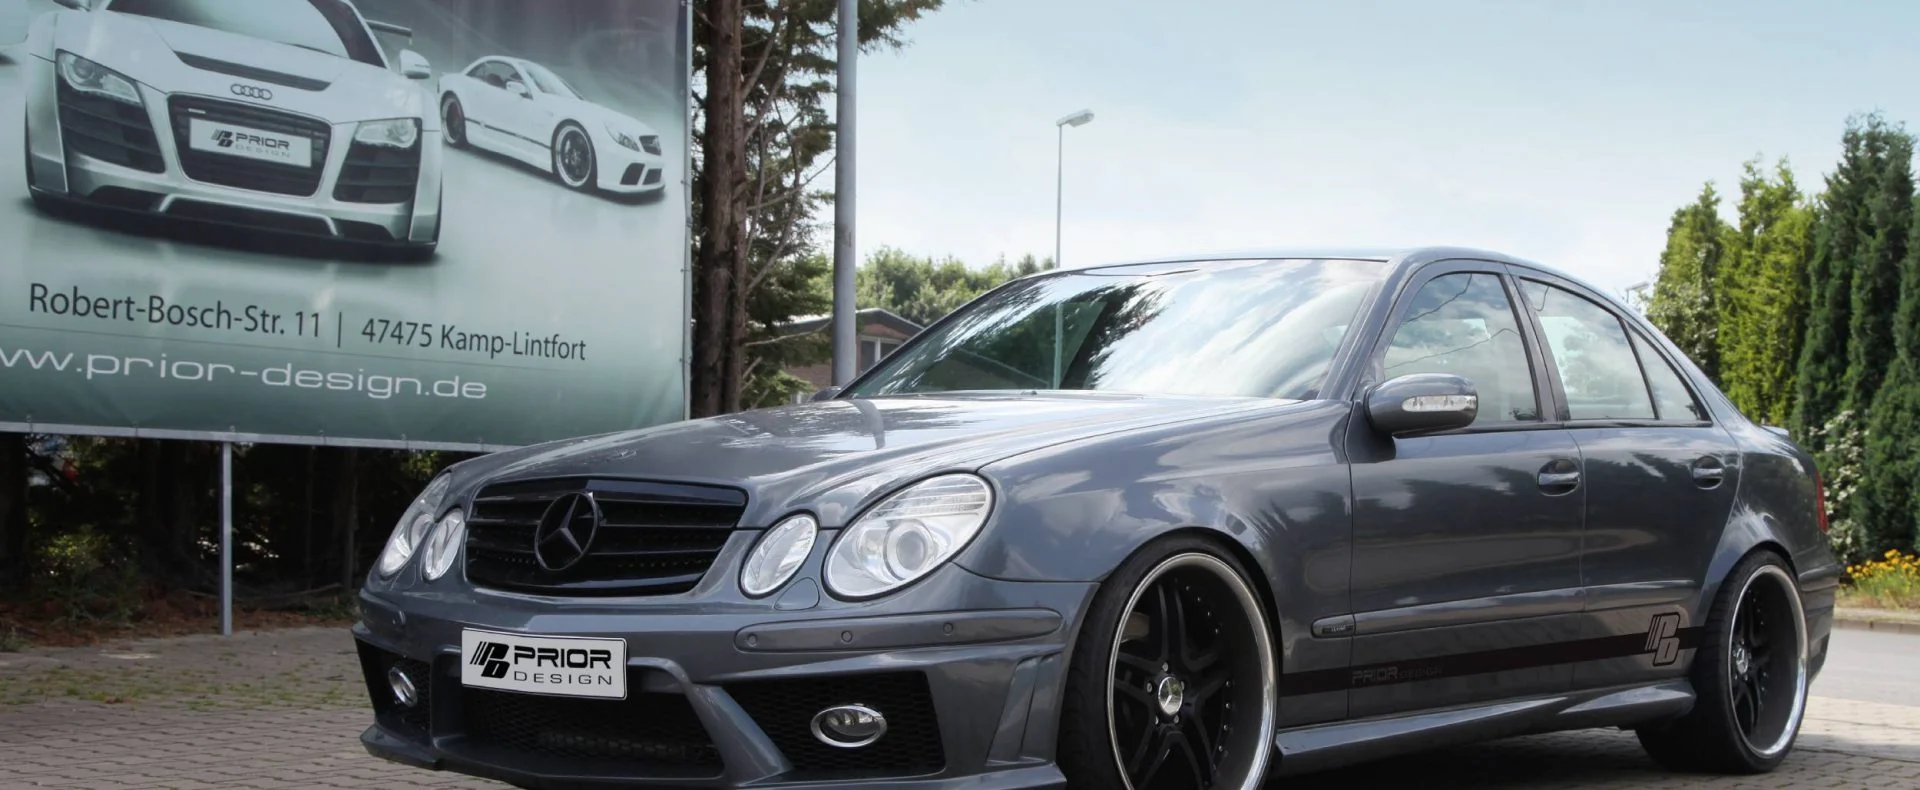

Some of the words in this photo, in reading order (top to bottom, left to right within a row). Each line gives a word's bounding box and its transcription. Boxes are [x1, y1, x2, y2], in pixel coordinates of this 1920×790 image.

[235, 132, 290, 150] PRIOR
[234, 144, 291, 158] DESIGN
[29, 283, 286, 335] Robert-Bosch-Str.
[295, 311, 321, 338] 11
[361, 317, 433, 348] 47475
[440, 324, 587, 361] Kamp-Lintfort
[513, 645, 612, 669] PRIOR
[513, 671, 612, 685] DESIGN
[1352, 666, 1398, 685] PRIOR
